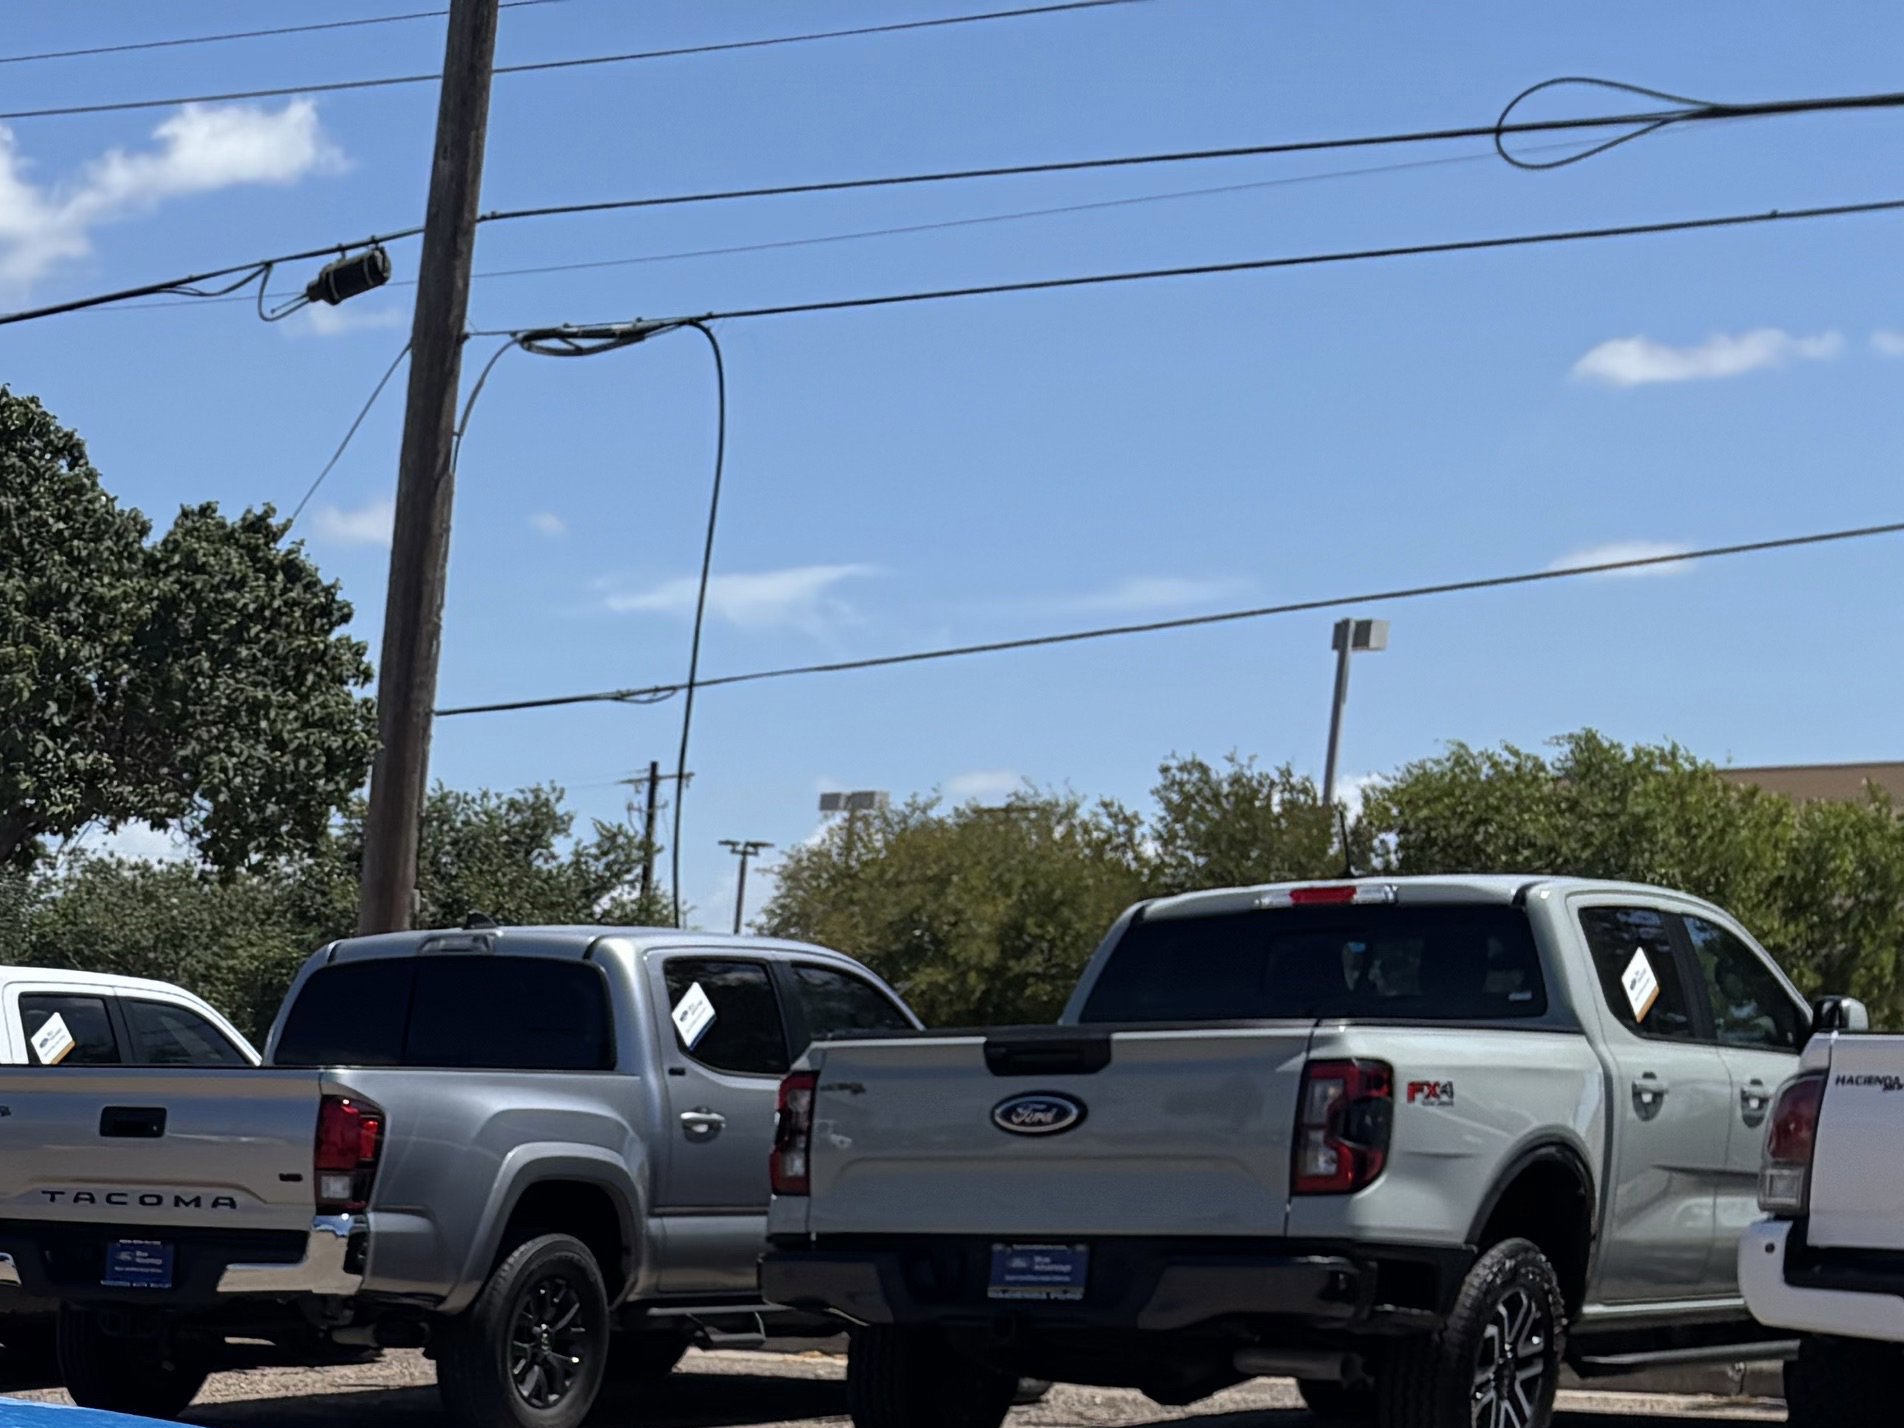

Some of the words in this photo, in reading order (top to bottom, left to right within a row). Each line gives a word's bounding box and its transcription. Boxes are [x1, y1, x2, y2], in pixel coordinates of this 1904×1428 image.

[1835, 1075, 1901, 1086] HACIENDA
[1407, 1081, 1454, 1103] FX4
[1011, 1103, 1057, 1124] Ford
[41, 1189, 237, 1210] TACOMA
